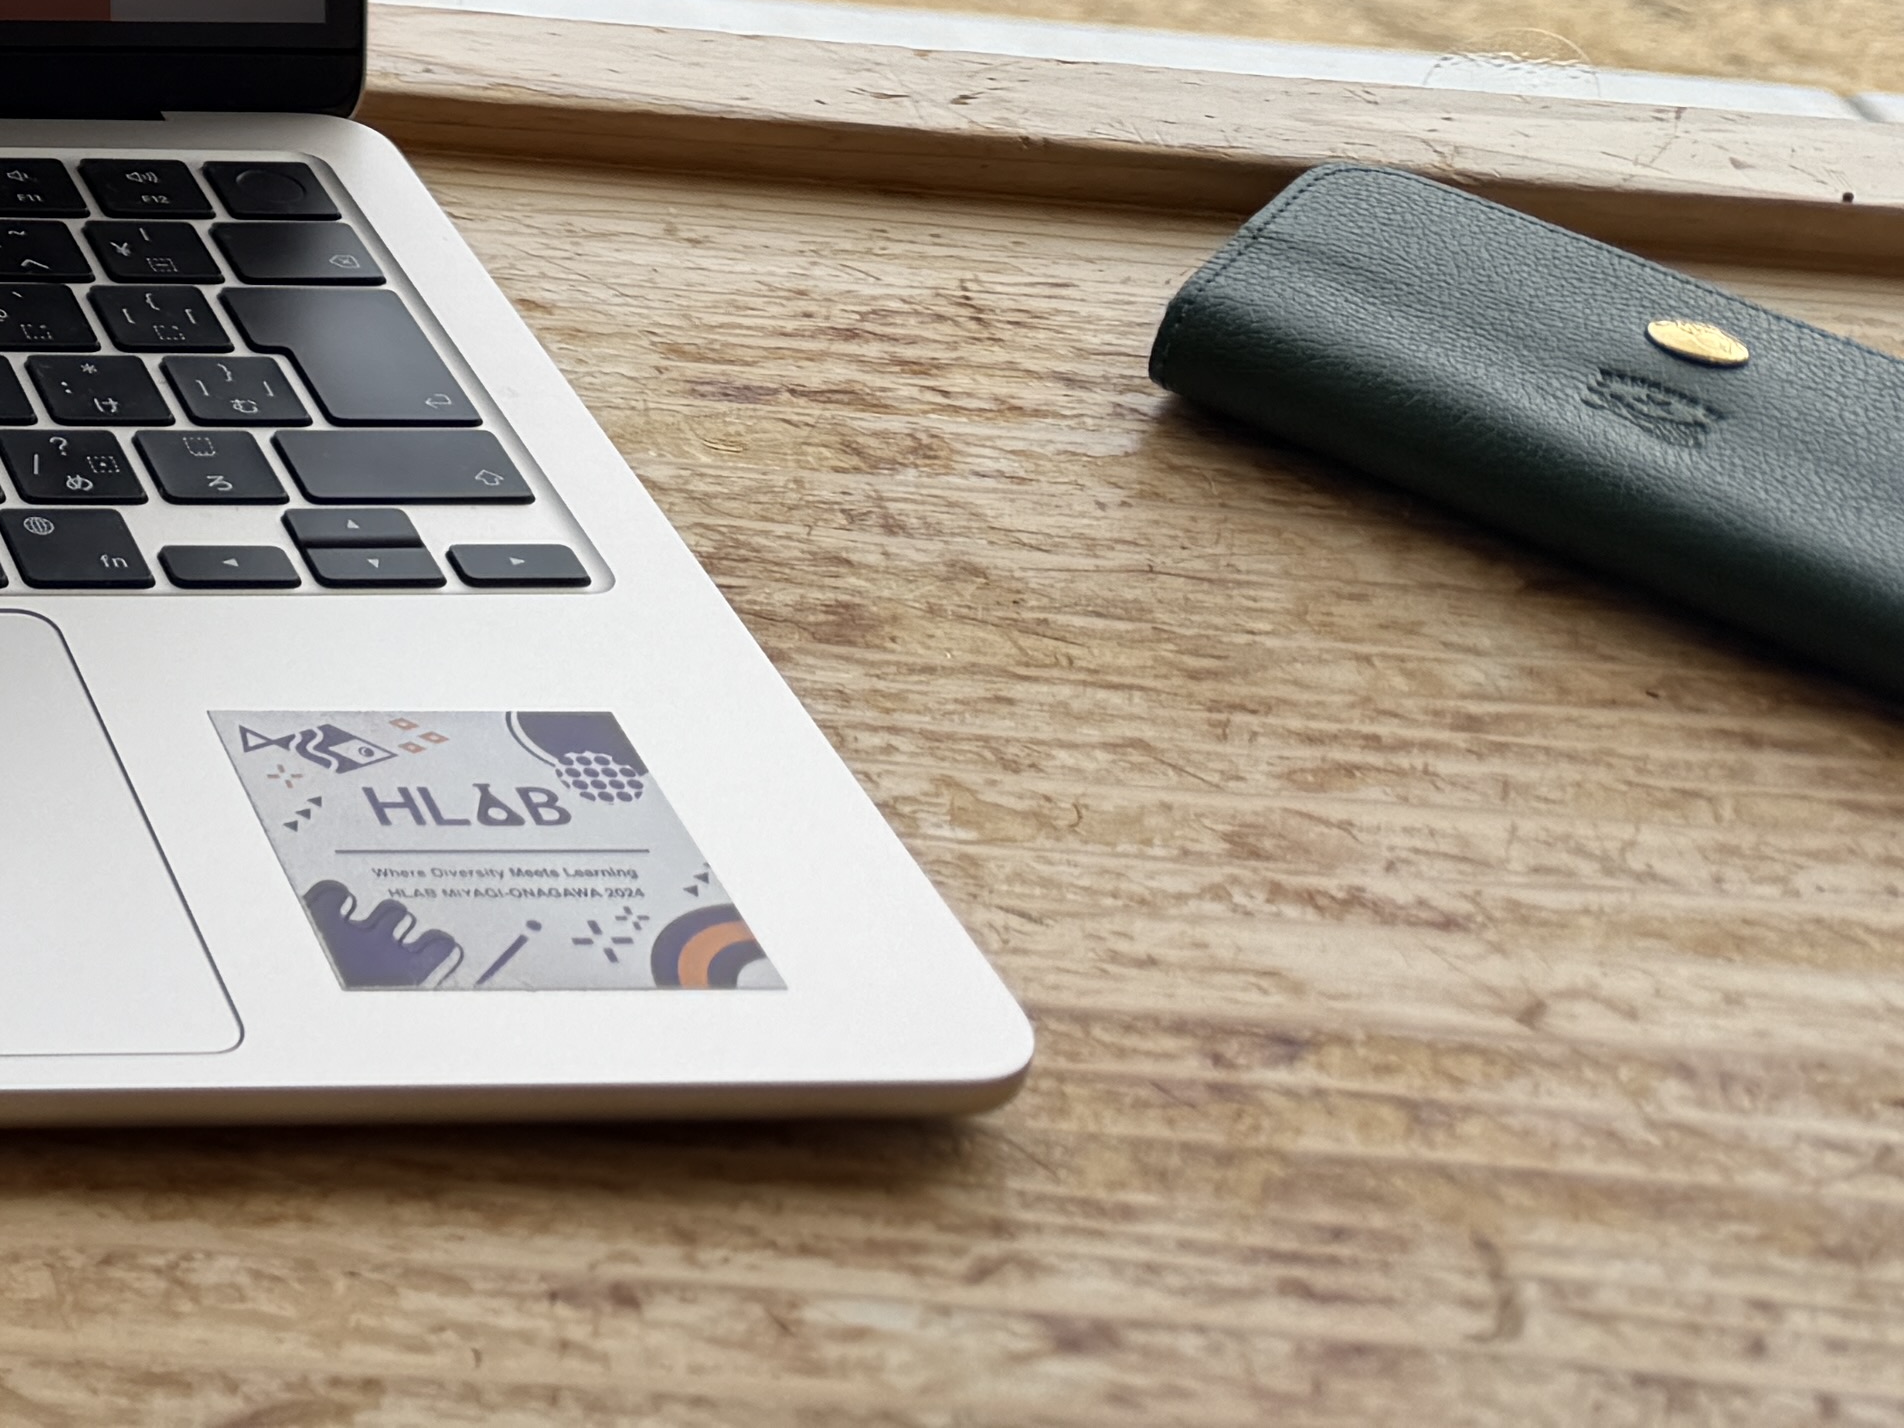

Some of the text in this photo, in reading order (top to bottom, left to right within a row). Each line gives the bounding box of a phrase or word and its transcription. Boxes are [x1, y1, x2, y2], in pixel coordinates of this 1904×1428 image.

[101, 555, 127, 567] fn
[371, 866, 639, 881] Where Diversity Meets Learning
